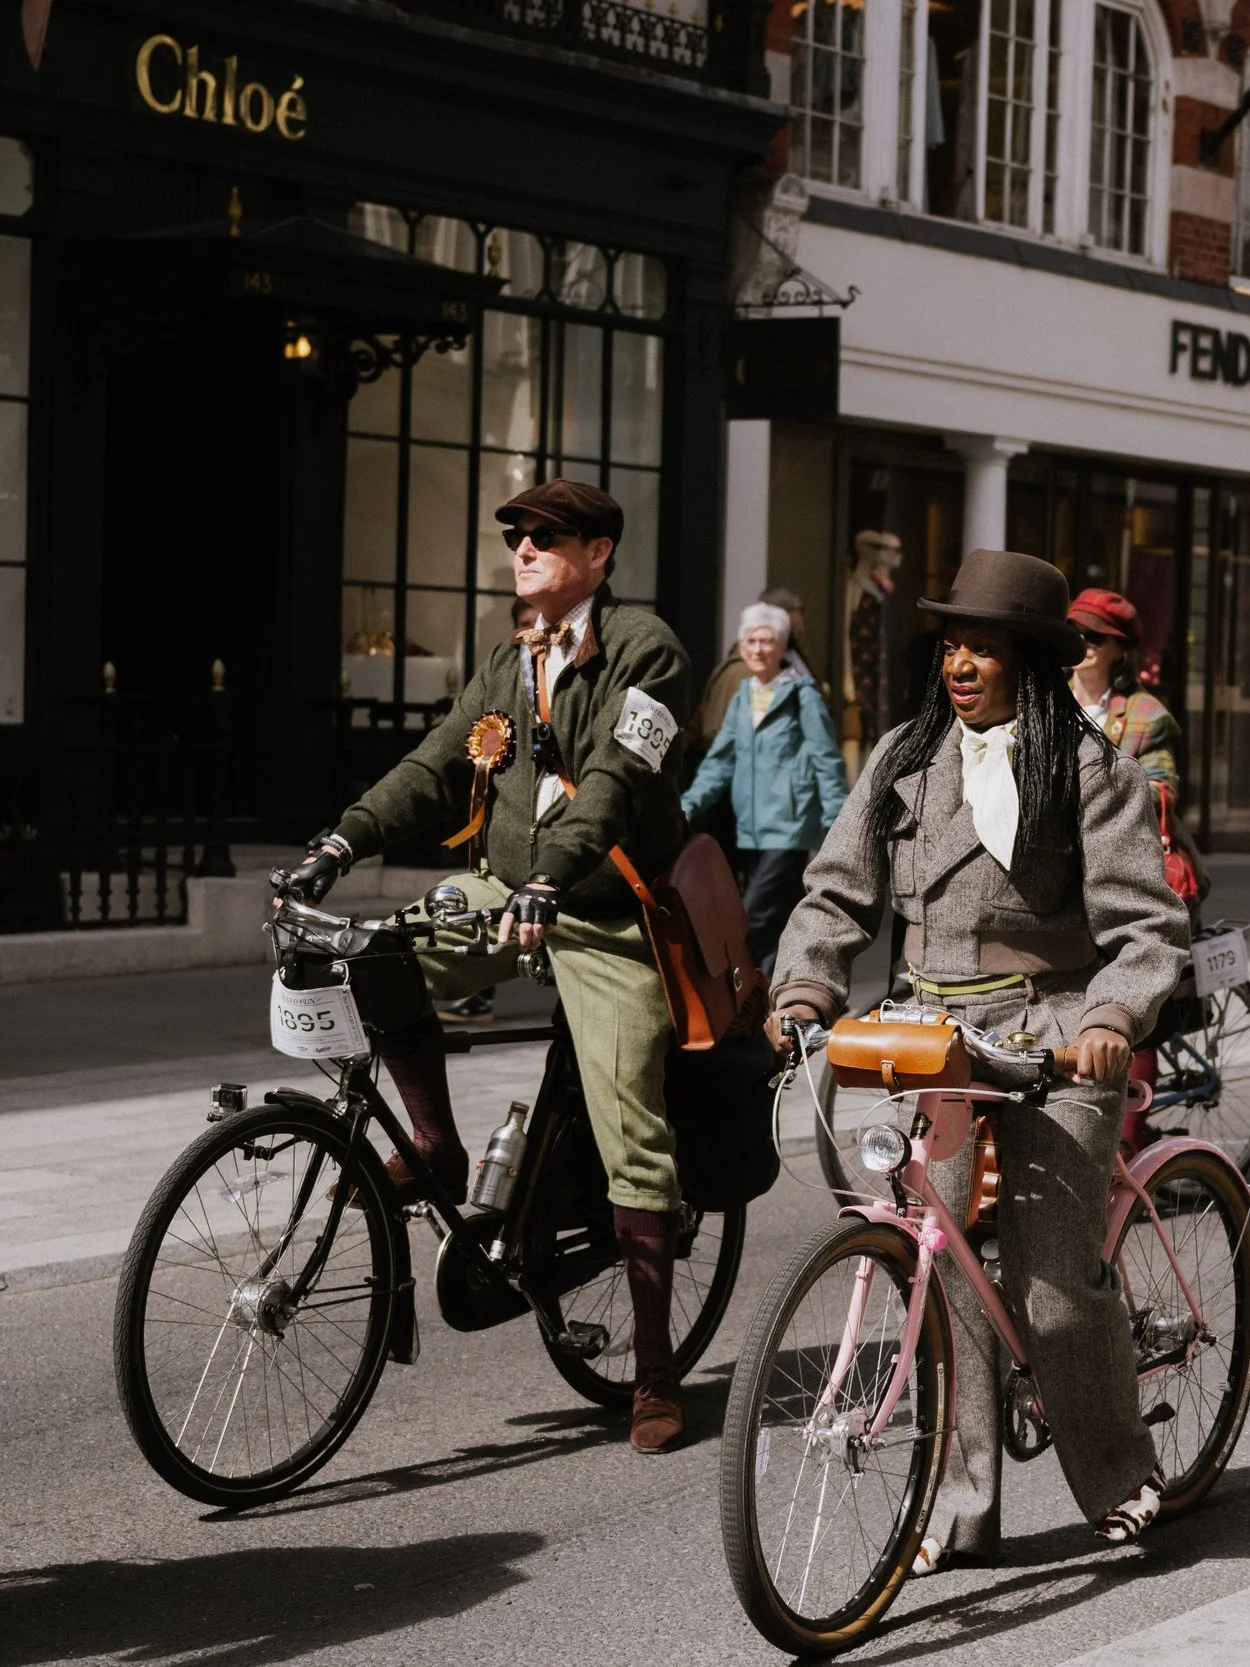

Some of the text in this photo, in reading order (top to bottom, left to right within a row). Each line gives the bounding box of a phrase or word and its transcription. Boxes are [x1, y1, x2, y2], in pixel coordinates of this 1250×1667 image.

[136, 34, 307, 140] Chloé
[1206, 950, 1236, 972] 1179
[278, 1005, 335, 1032] 1895
